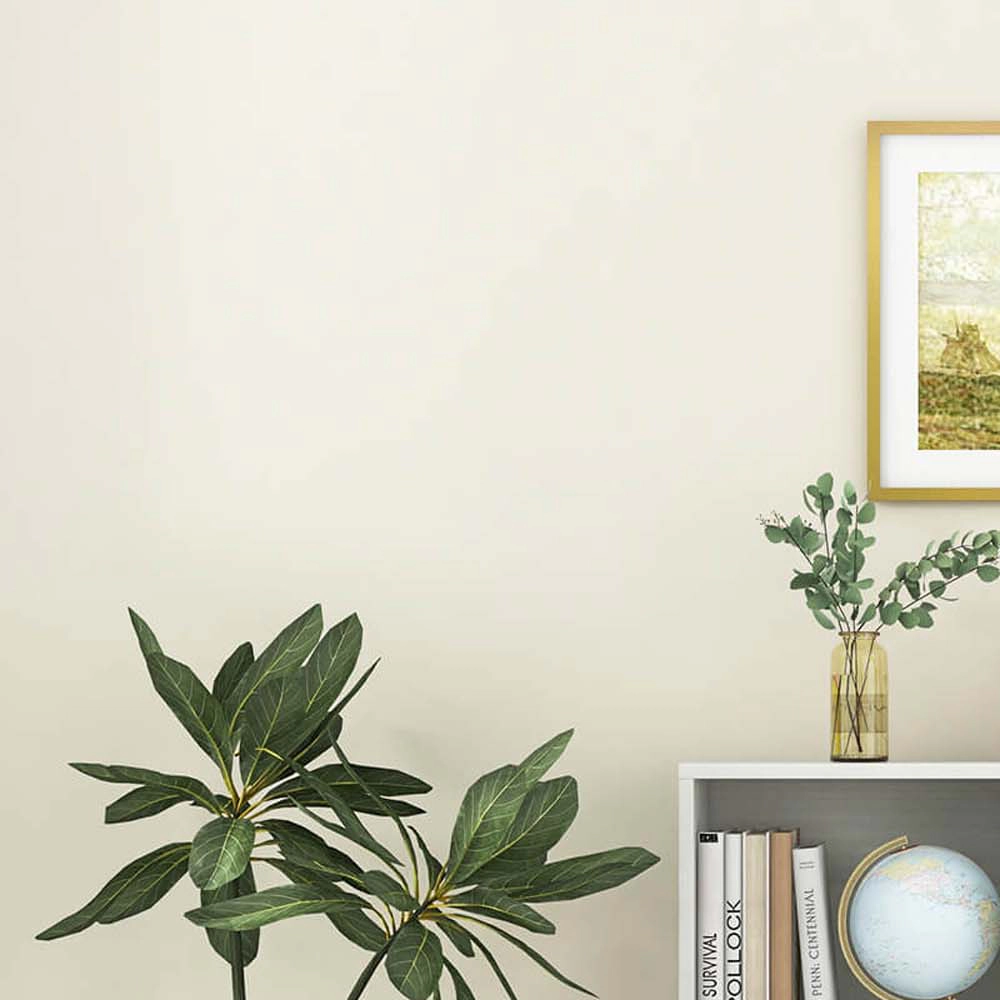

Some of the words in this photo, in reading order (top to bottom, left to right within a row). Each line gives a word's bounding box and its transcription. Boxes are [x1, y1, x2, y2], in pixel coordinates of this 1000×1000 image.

[803, 888, 820, 960] CENTENNIAL
[702, 933, 718, 997] SURVIVAL
[808, 963, 823, 997] PENN:
